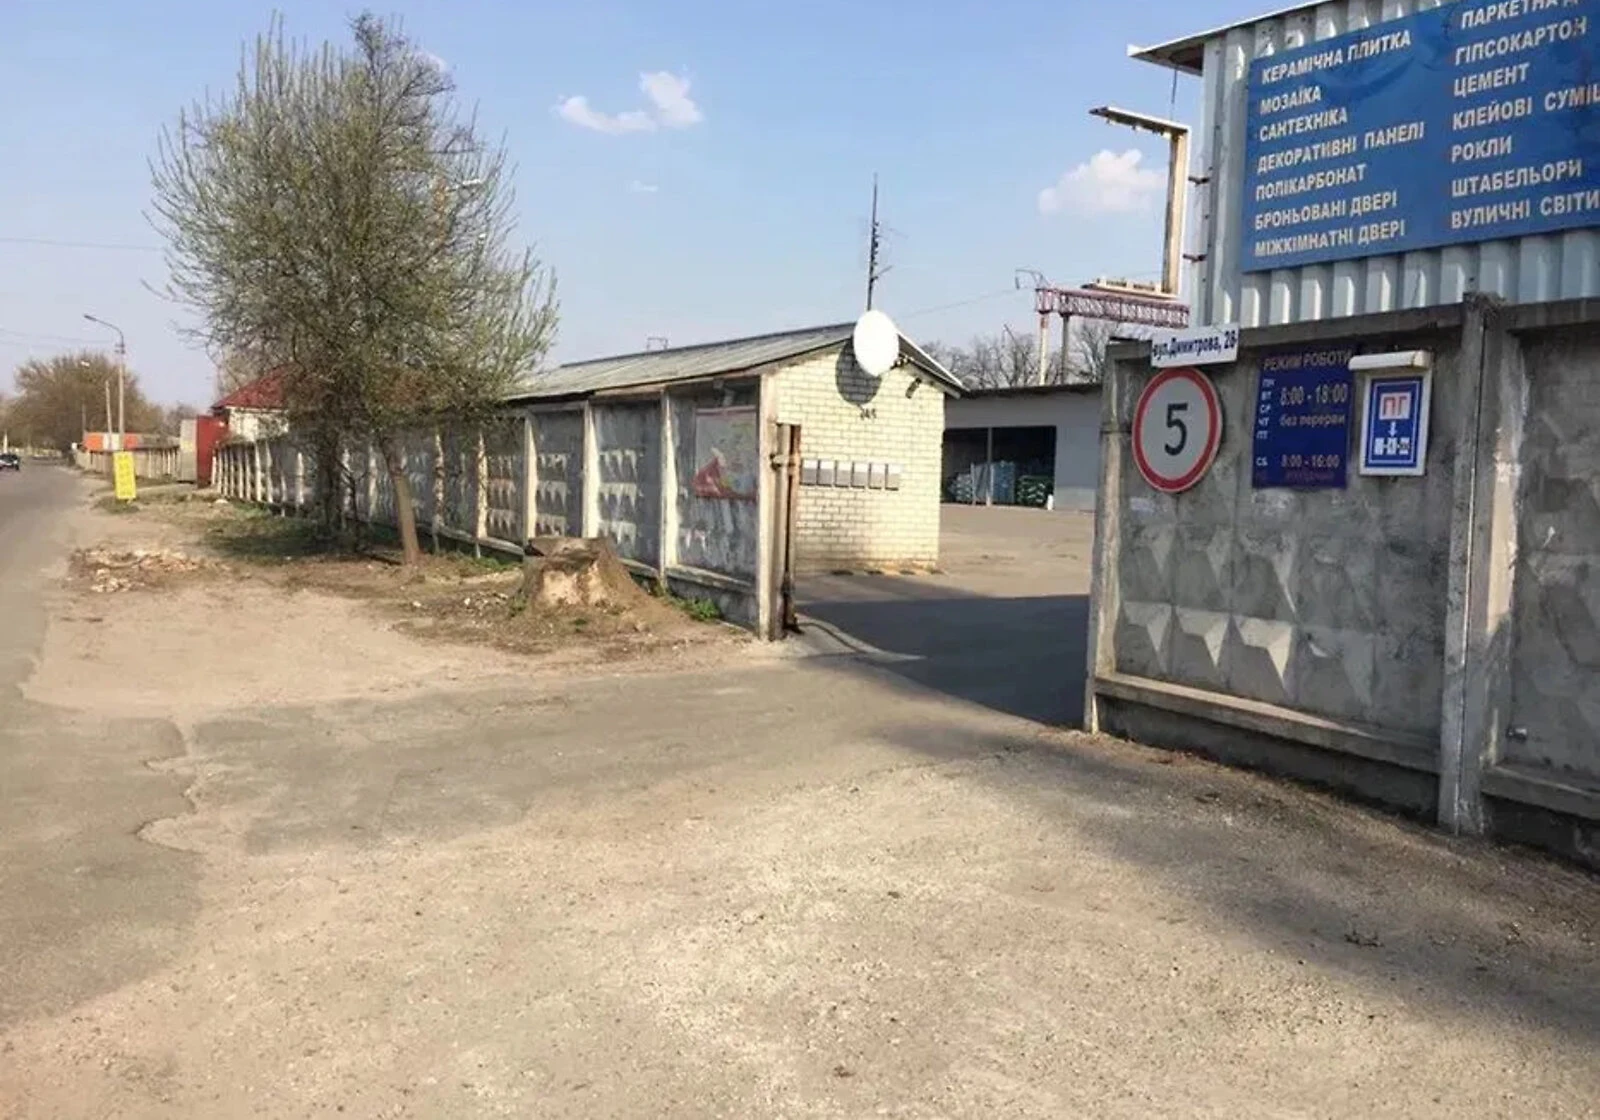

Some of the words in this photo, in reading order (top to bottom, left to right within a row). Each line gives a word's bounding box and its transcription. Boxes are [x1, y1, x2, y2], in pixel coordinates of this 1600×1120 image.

[1262, 55, 1344, 85] КЕРАМІЧНА
[1347, 30, 1412, 62] ПЛИТКА
[1455, 16, 1588, 66] ГІПСОКАРТОН
[1453, 62, 1531, 98] ЦЕМЕНТ
[1259, 85, 1322, 115] МОЗАЇКА
[1452, 97, 1533, 131] КЛЕЙОВІ
[1259, 107, 1349, 142] САНТЕХНІКА
[1257, 136, 1357, 175] ДЕКОРАТИВНІ
[1364, 121, 1425, 153] ПАНЕЛІ
[1451, 135, 1513, 164] РОКЛИ
[1256, 163, 1367, 202] ПОЛІКАРБОНАТ
[1451, 158, 1583, 198] ШТАБЕЛЬОРИ
[1255, 200, 1347, 230] БРОНЬОВАНІ
[1350, 190, 1397, 216] ДВЕРІ
[1451, 198, 1531, 229] ВУЛИЧНІ
[1255, 228, 1354, 257] МІЖКІМНАТНІ
[1358, 219, 1407, 245] ДВЕРІ
[1164, 402, 1188, 456] 5
